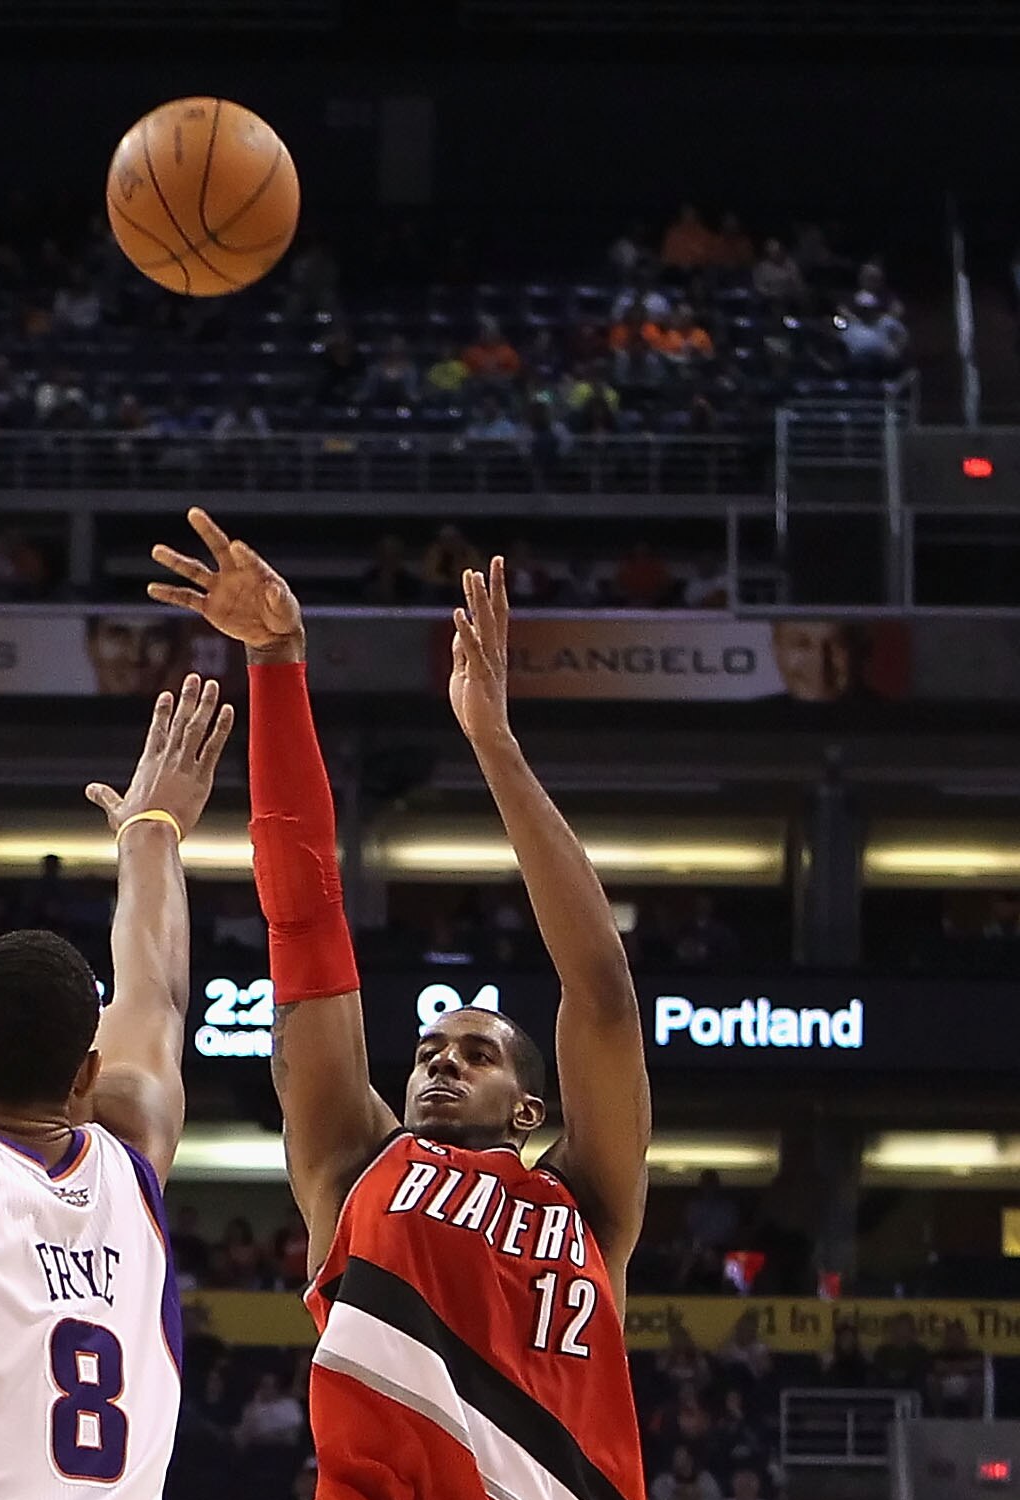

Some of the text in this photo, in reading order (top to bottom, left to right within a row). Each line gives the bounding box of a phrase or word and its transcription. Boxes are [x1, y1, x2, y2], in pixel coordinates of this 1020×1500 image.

[507, 646, 758, 676] LANGELO
[204, 977, 275, 1026] 2:2
[654, 995, 865, 1049] Portland
[194, 1025, 273, 1056] Quar
[35, 1242, 120, 1307] FRYE
[531, 1270, 598, 1359] 12
[48, 1315, 129, 1486] 8
